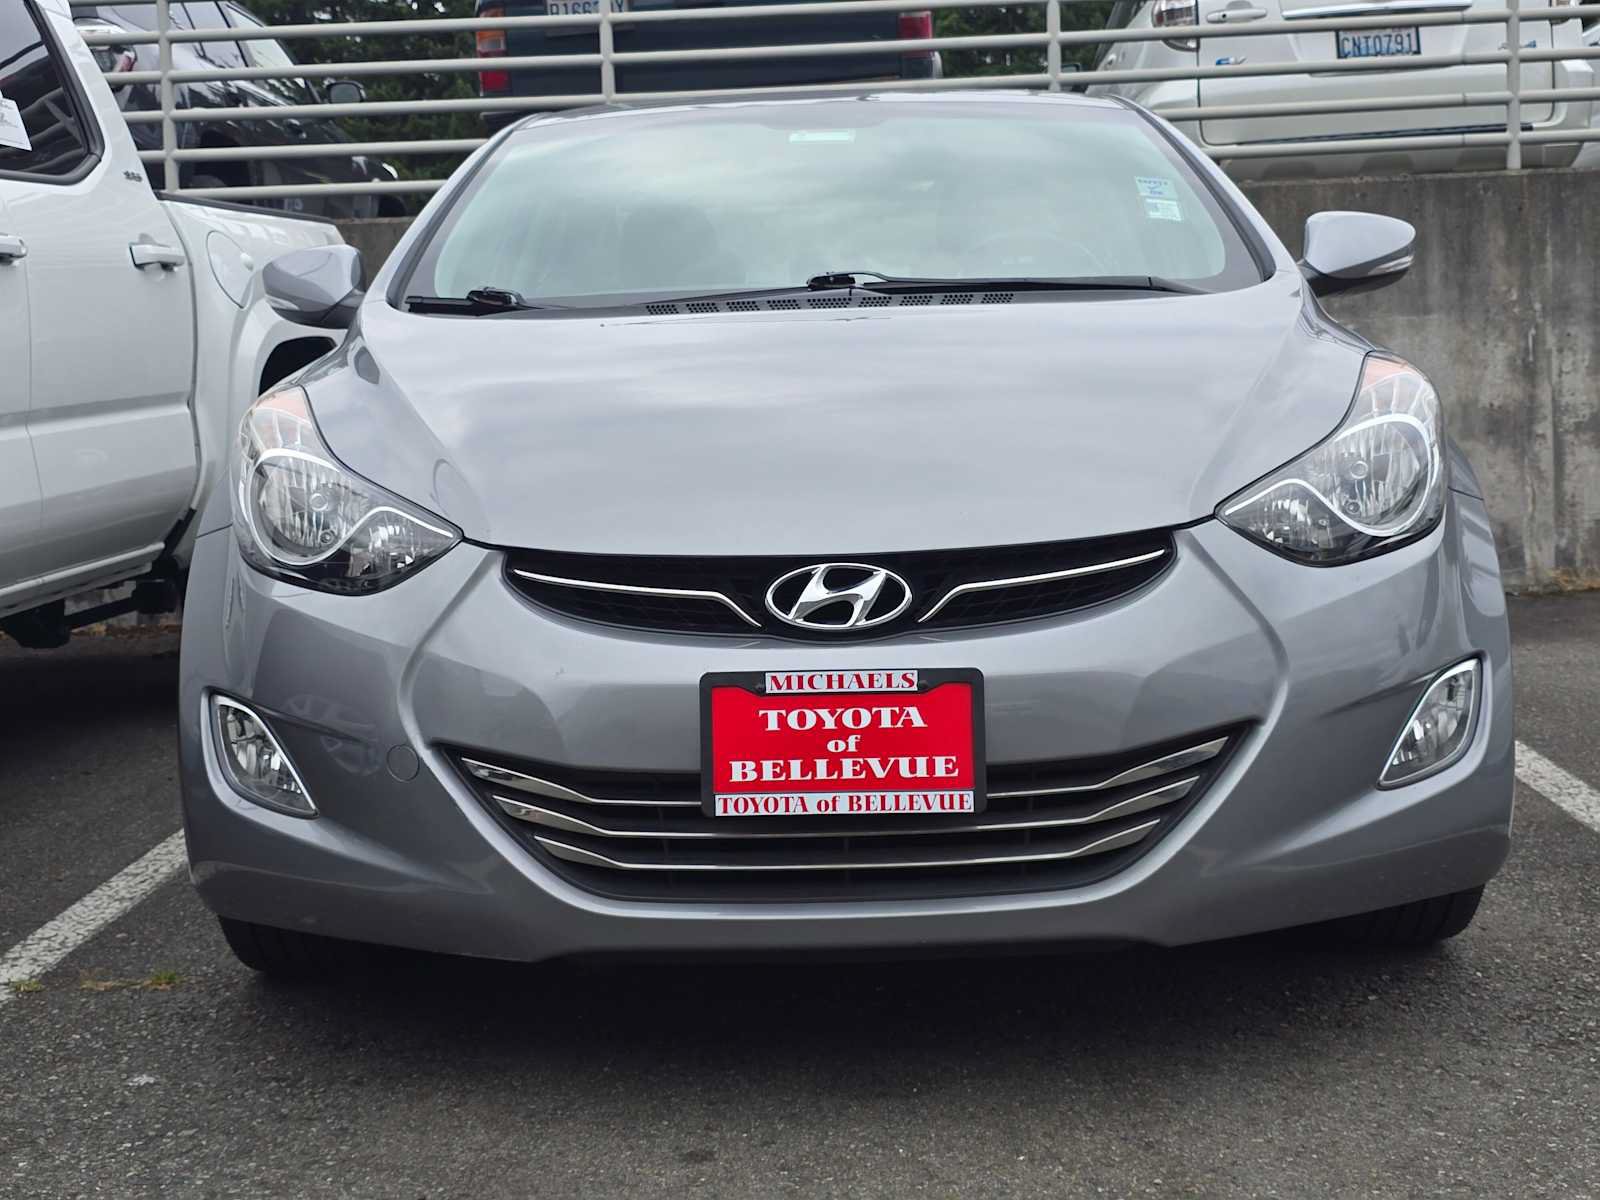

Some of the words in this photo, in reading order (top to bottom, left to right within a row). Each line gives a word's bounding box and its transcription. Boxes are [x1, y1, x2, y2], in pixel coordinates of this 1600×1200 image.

[1341, 33, 1412, 56] CNT0791
[769, 672, 916, 690] MICHAELS
[758, 706, 928, 731] TOYOTA
[826, 734, 861, 753] of
[729, 755, 959, 783] BELLEVUE
[718, 795, 808, 815] TOYOTA
[816, 795, 840, 813] of
[847, 793, 973, 812] BELLEVUE
